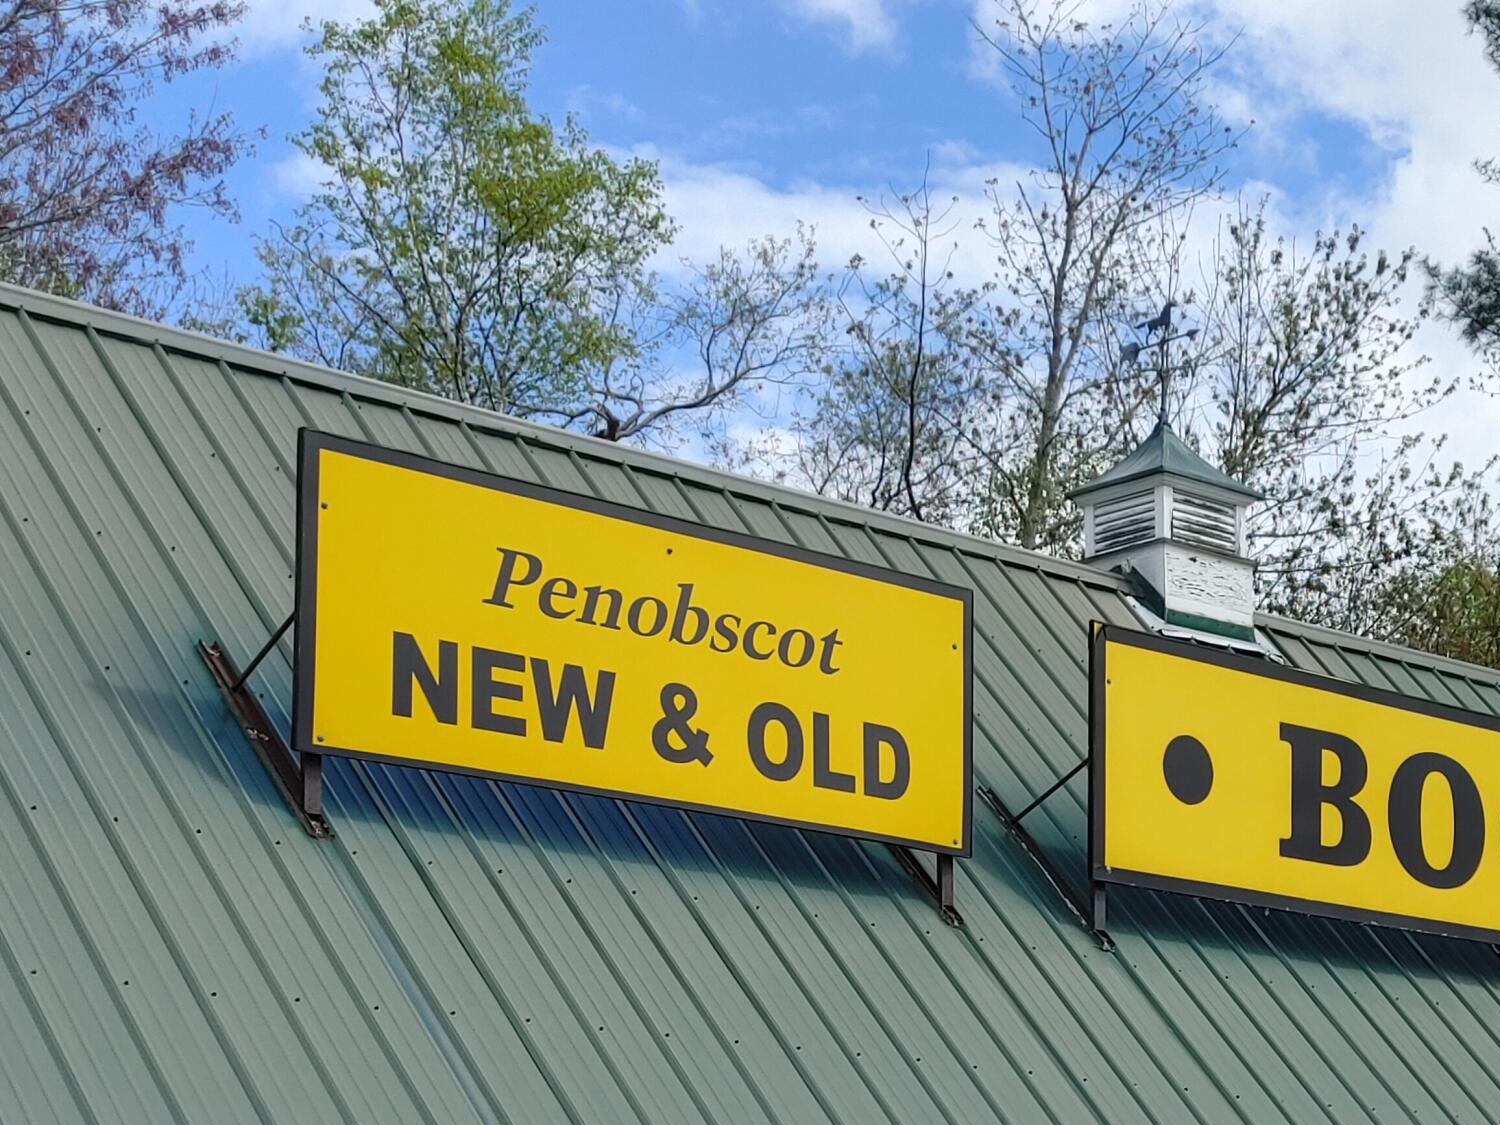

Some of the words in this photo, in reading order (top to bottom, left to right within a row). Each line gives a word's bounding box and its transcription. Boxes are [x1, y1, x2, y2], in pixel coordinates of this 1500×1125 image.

[482, 547, 843, 674] Penobscot
[391, 631, 616, 750] NEW
[651, 683, 714, 767] &
[747, 702, 911, 800] OLD
